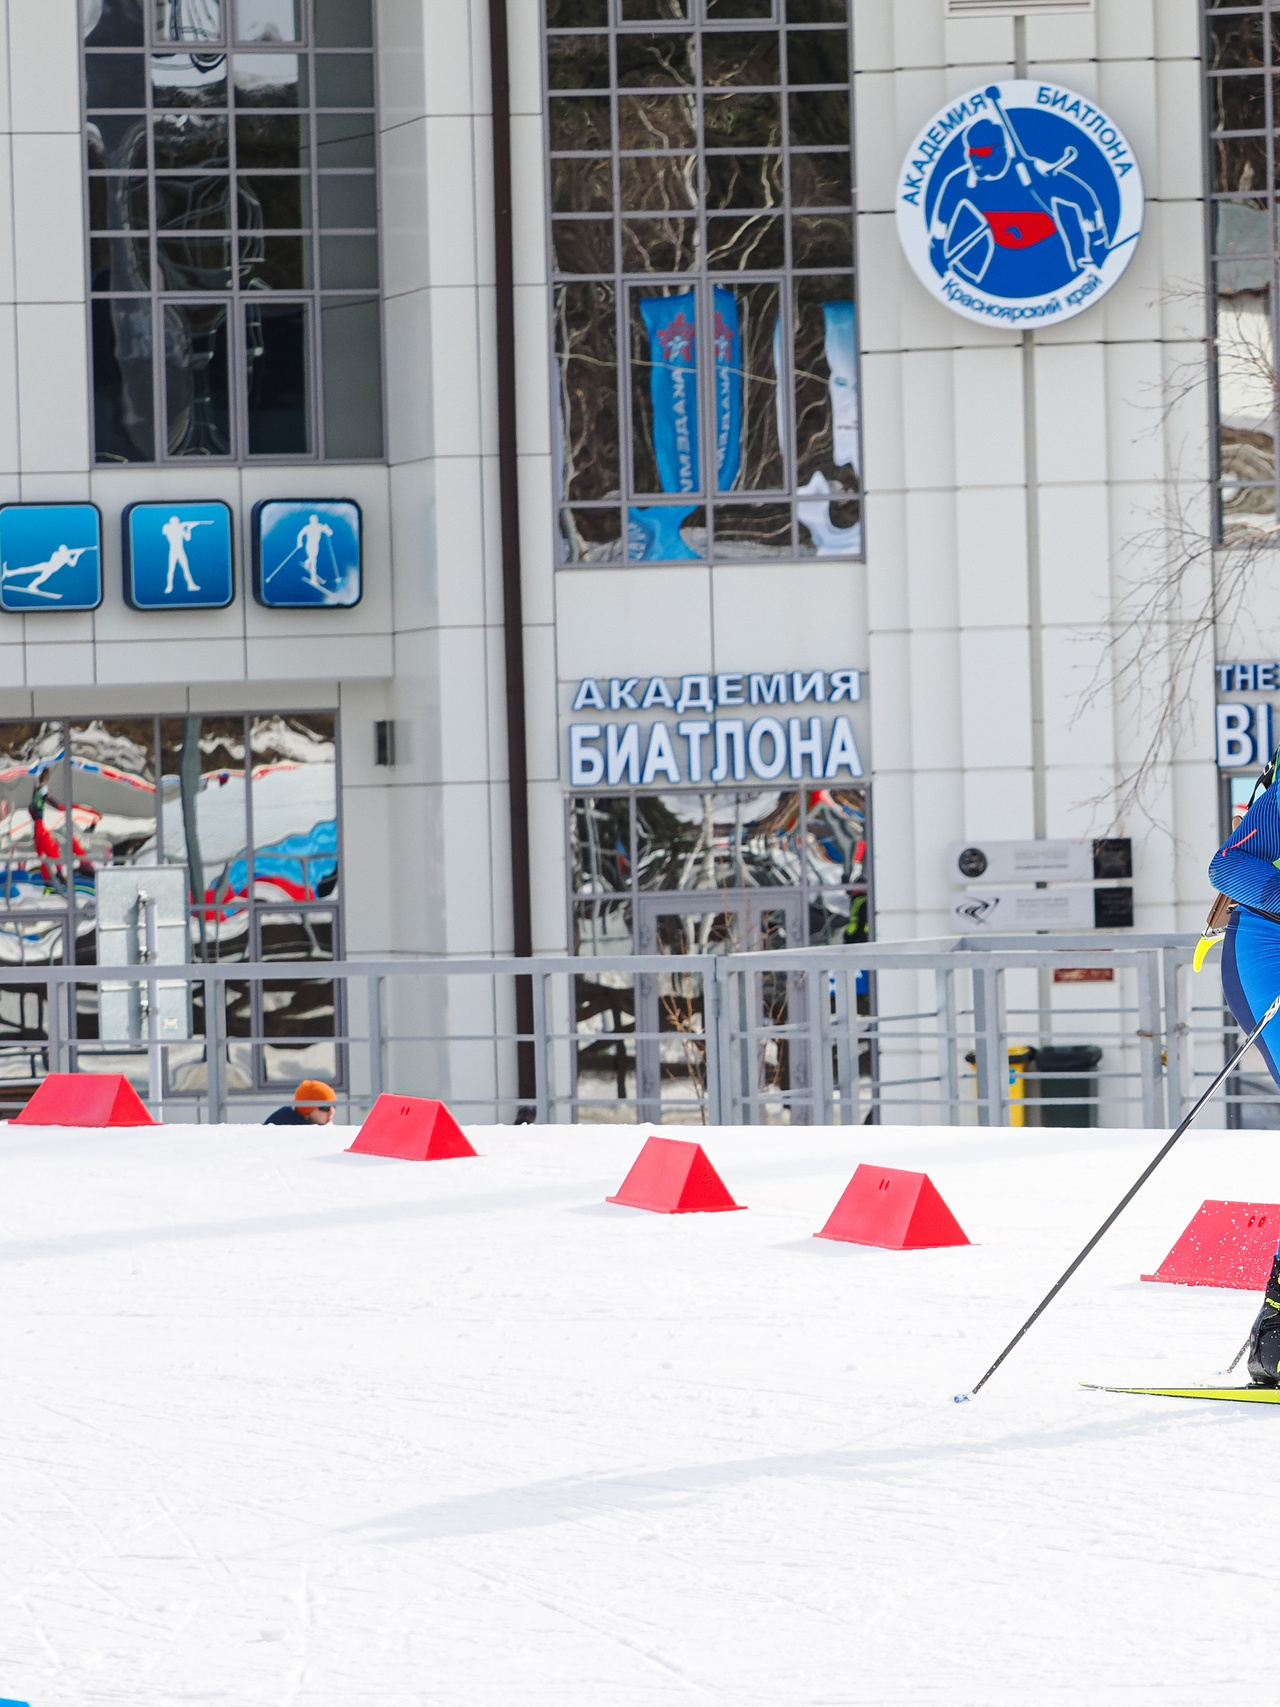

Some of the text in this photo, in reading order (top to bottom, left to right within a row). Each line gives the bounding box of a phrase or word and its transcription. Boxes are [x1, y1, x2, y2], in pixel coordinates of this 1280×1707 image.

[902, 93, 988, 206] АКАДЕМИЯ
[1036, 86, 1134, 177] БИАТЛОНА
[941, 273, 1103, 322] Красноярский край
[572, 669, 861, 714] АКАДЕМИЯ
[1215, 662, 1279, 691] THE
[570, 715, 863, 787] БИАТЛОНА
